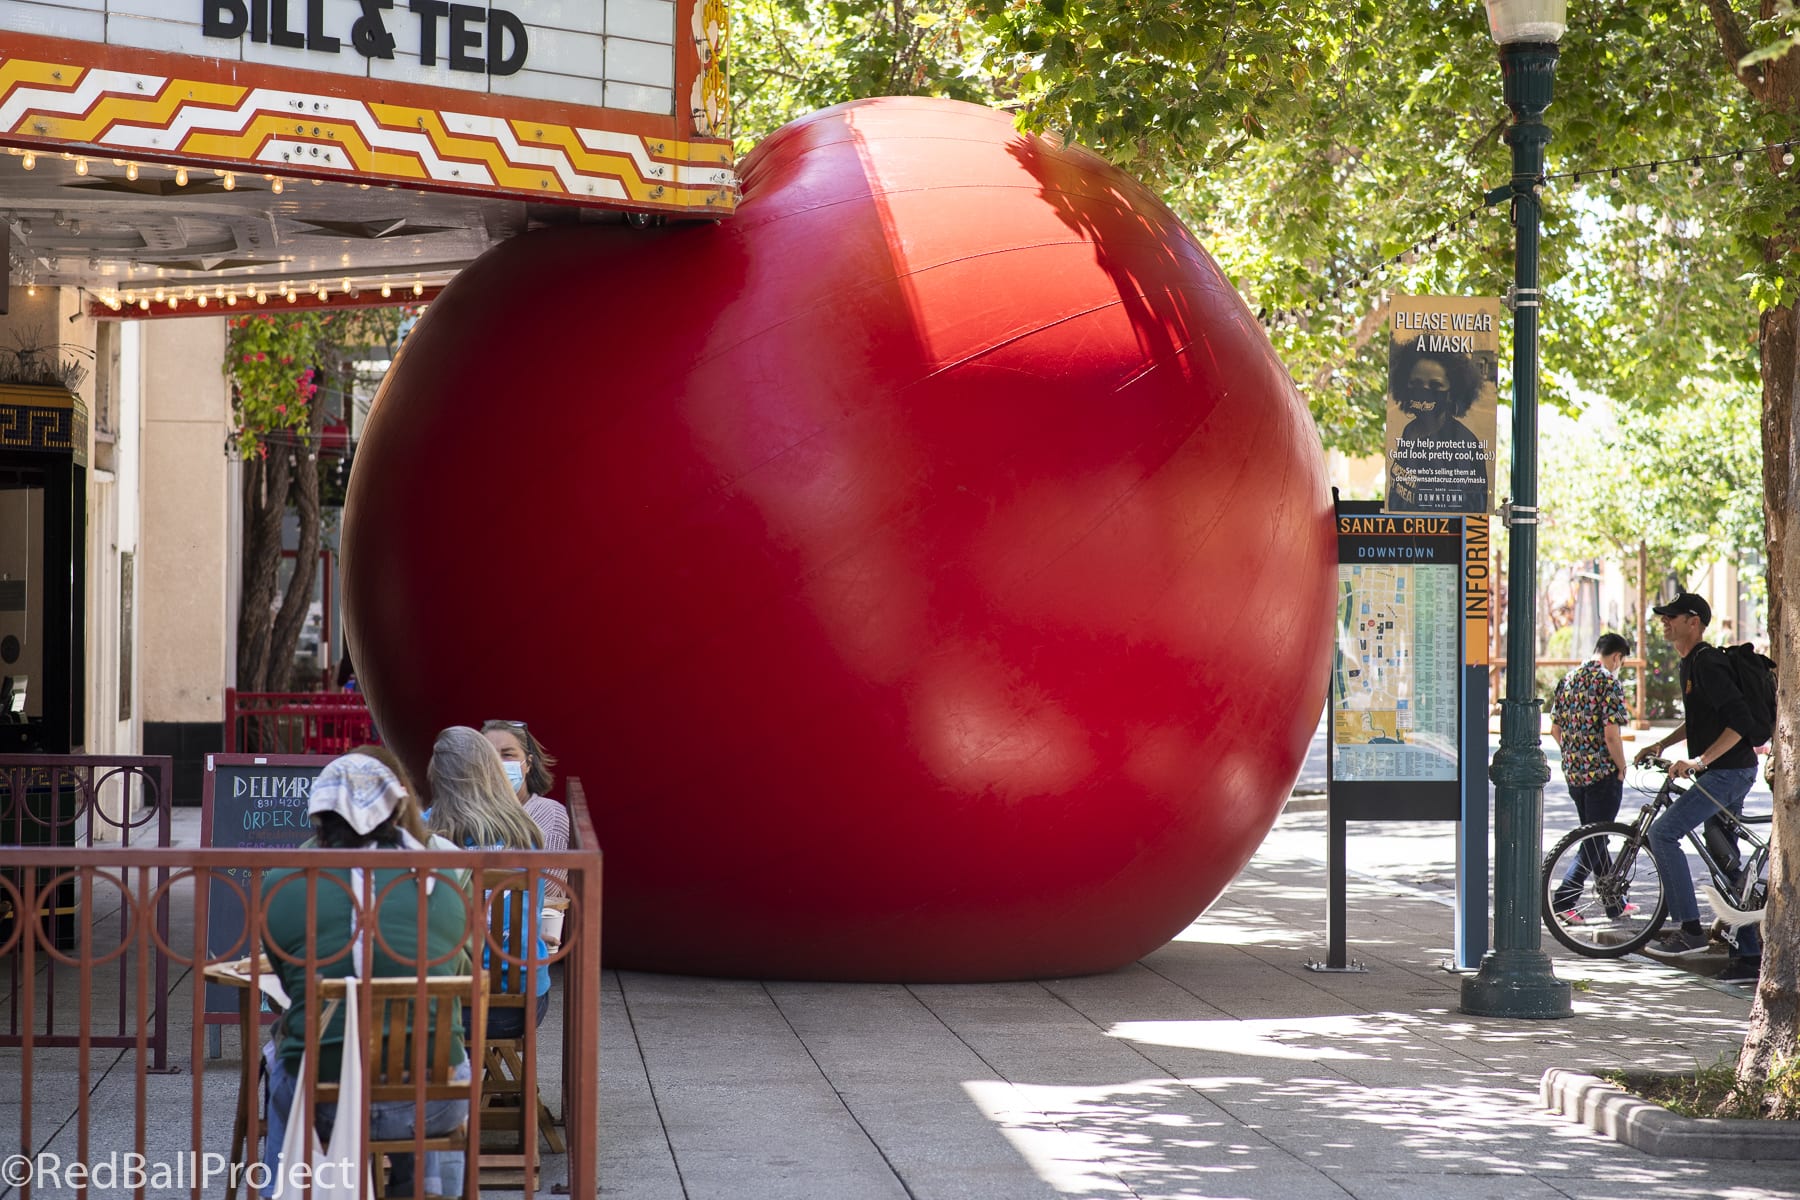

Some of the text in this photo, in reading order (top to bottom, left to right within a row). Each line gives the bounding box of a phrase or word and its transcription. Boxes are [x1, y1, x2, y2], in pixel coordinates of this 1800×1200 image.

[203, 0, 529, 76] BILL & TED
[1395, 311, 1492, 332] PLEASE WEAR
[1416, 335, 1474, 353] A MASK!
[1395, 438, 1488, 450] They help protect us all
[1389, 449, 1495, 461] (and look pretty cool, too!)
[1406, 467, 1417, 475] See
[1417, 467, 1434, 475] who's
[1434, 468, 1453, 476] selling
[1453, 468, 1469, 476] them
[1395, 475, 1486, 485] downtownsantacruz.com/masks
[1418, 493, 1463, 502] DOWNTOWN
[1340, 517, 1449, 534] SANTA CRUZ
[1358, 547, 1434, 558] DOWNTOWN
[279, 798, 306, 808] 420-
[243, 809, 296, 830] ORDER
